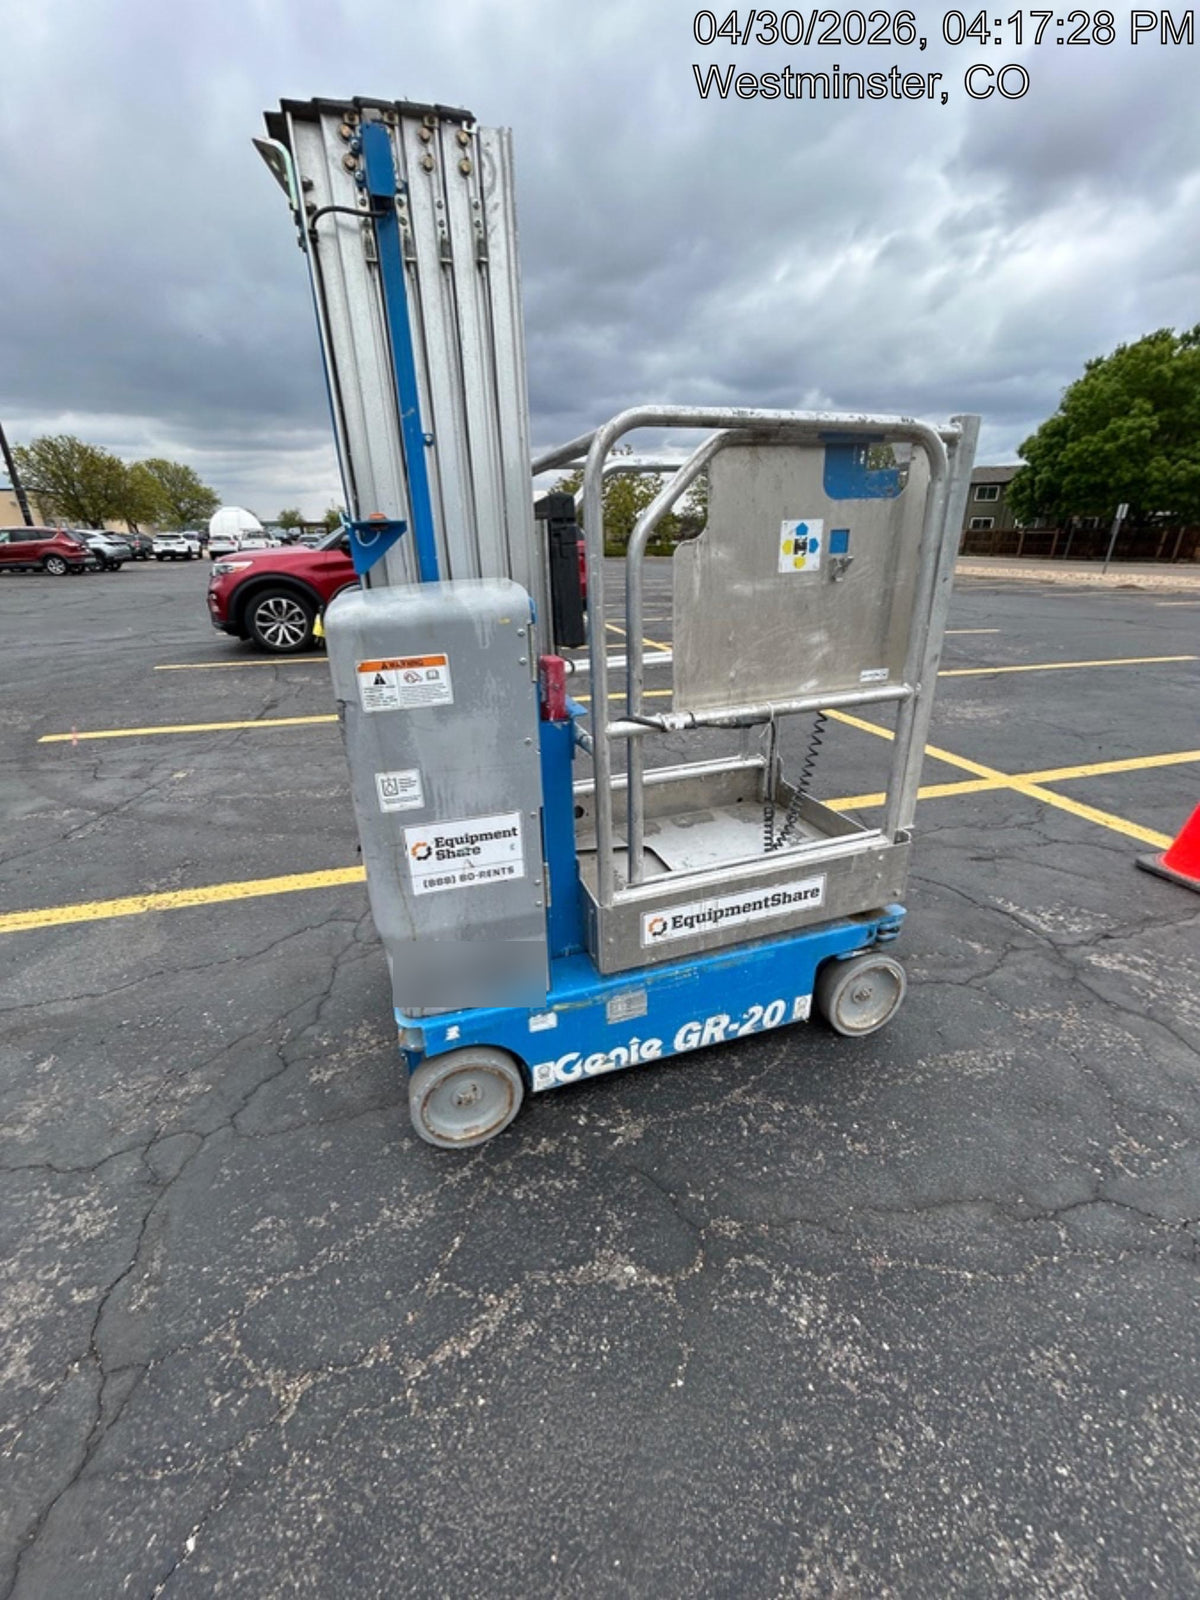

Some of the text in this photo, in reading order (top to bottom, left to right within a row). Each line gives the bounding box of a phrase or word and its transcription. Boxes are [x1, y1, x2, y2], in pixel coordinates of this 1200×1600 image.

[434, 827, 518, 848] Equipment
[435, 846, 481, 861] Share
[671, 887, 820, 931] EquipmentShare
[554, 1036, 663, 1082] Genie
[673, 999, 786, 1052] GR-20
